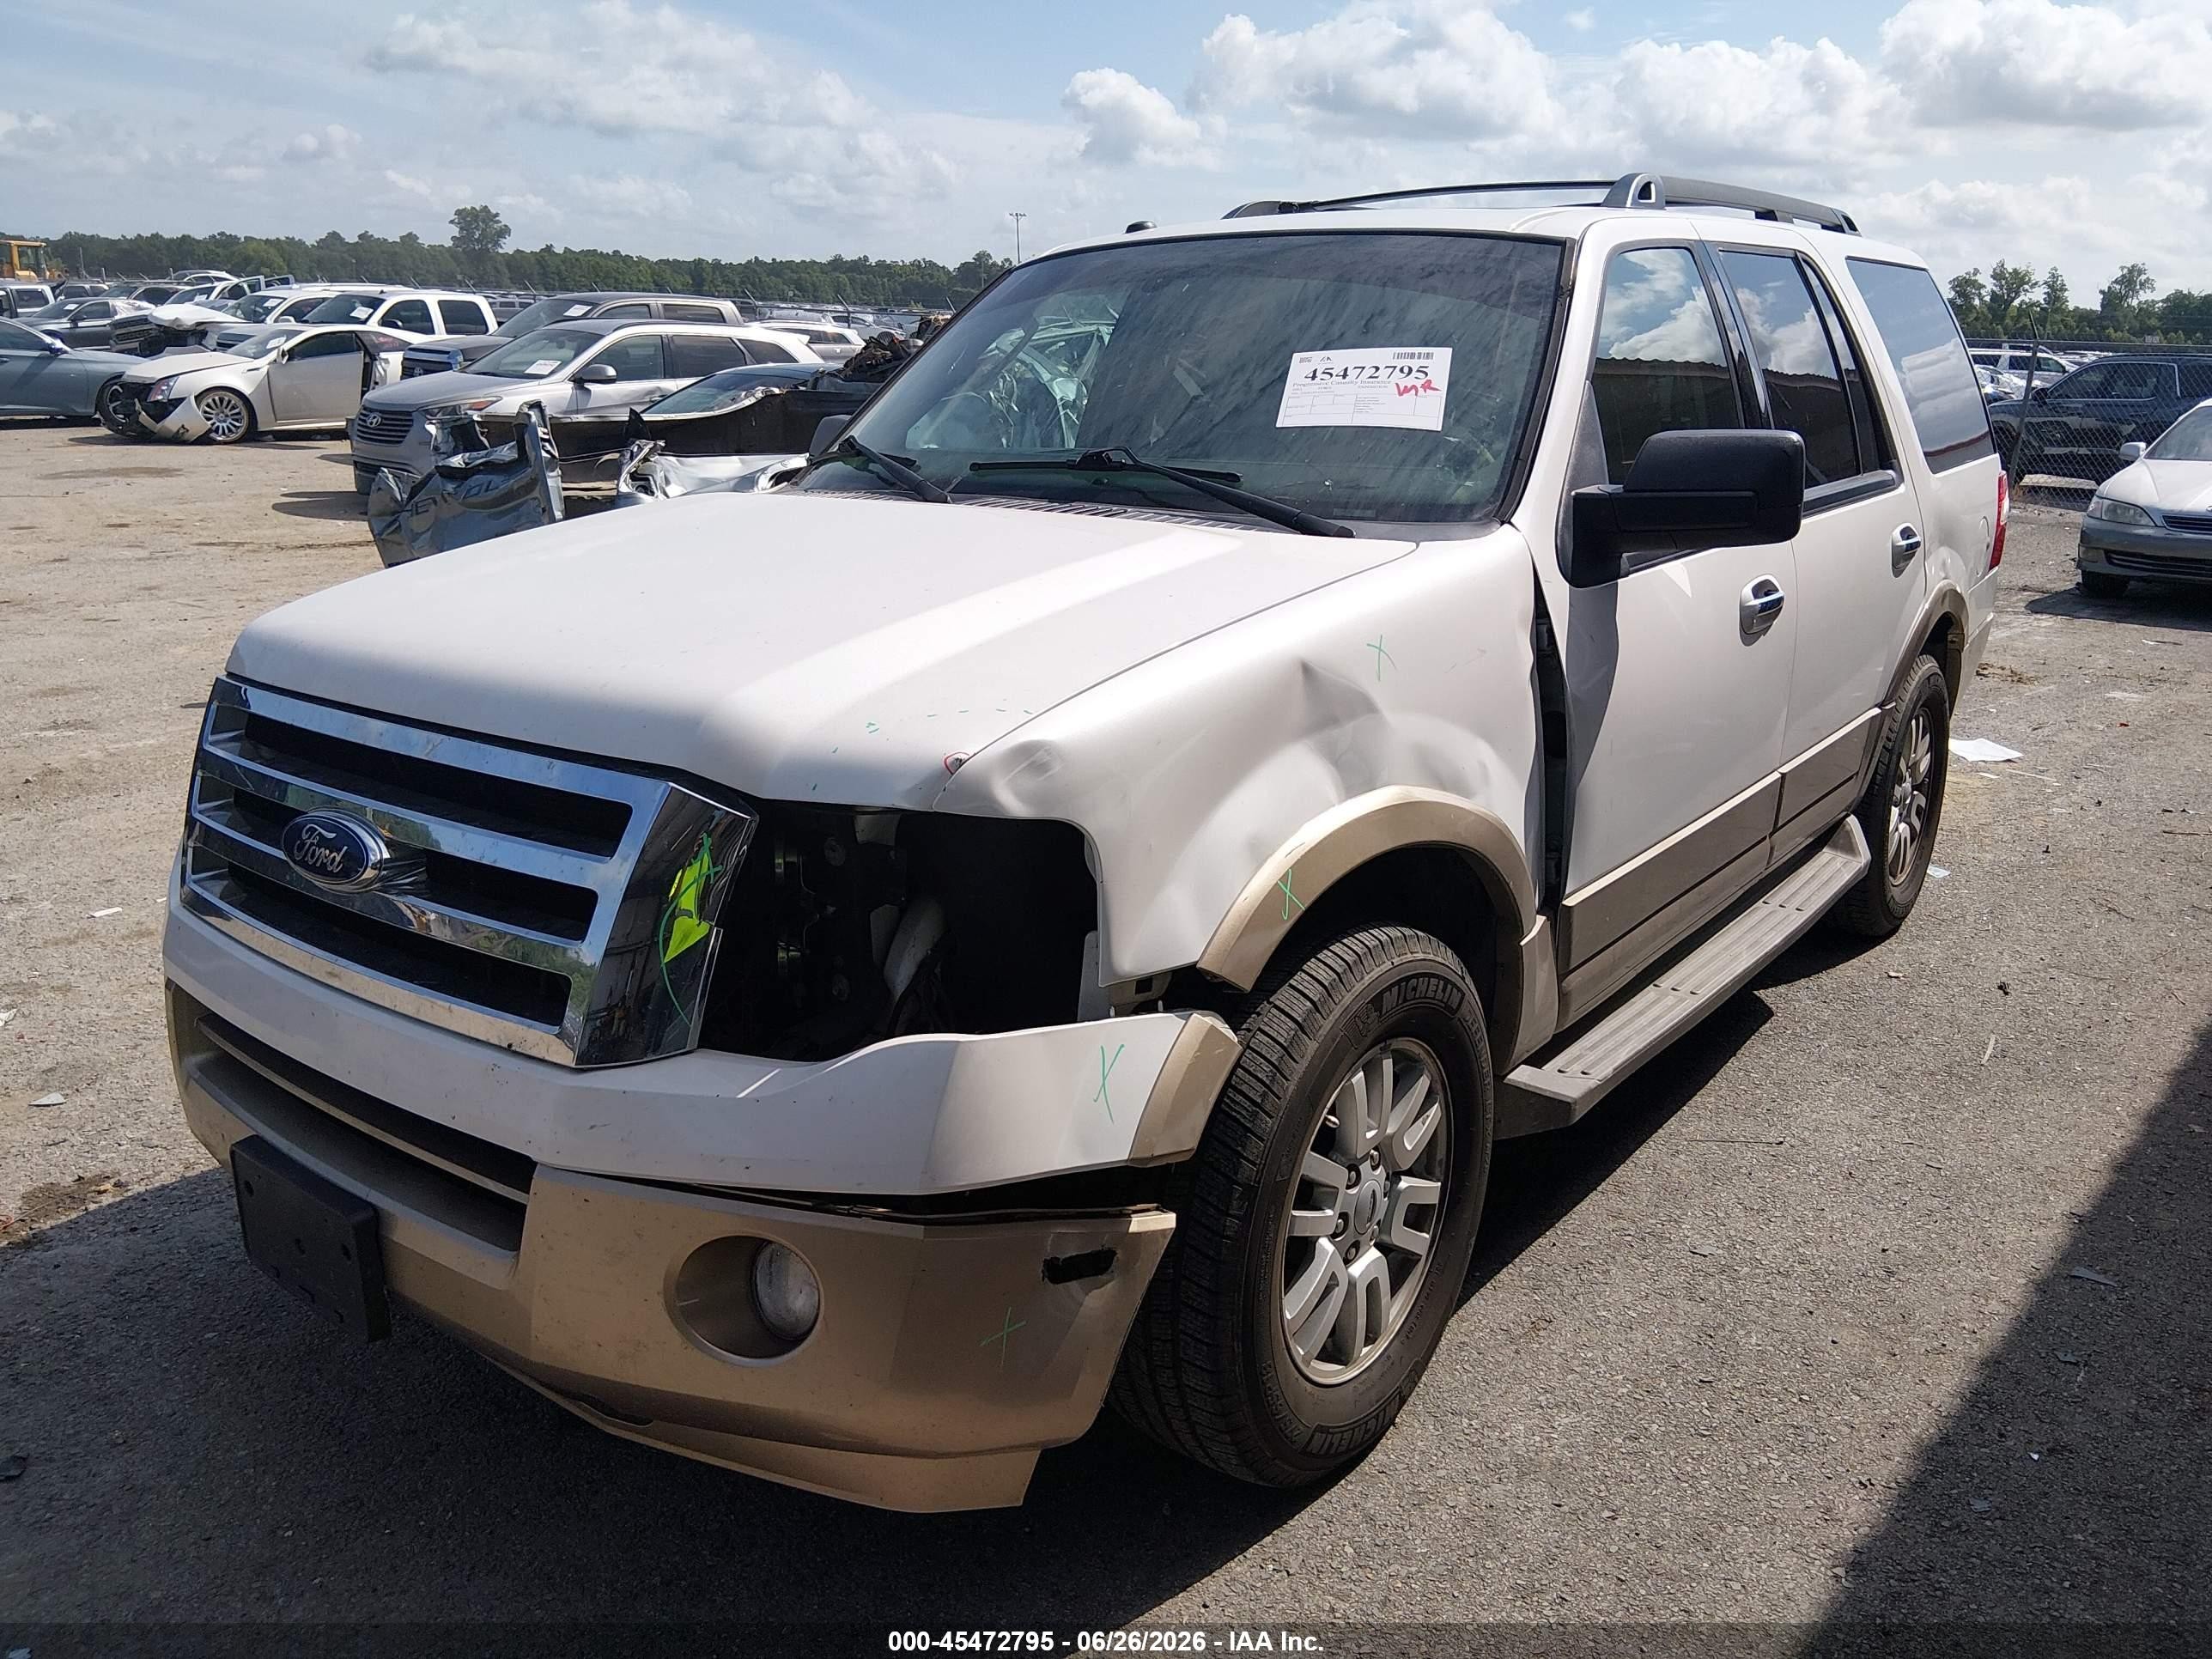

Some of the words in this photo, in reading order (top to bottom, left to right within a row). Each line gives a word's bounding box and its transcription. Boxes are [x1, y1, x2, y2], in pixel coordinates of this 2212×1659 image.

[1304, 365, 1430, 381] 45472795
[293, 823, 349, 873] Ford
[1381, 976, 1463, 1015] MICHELIN
